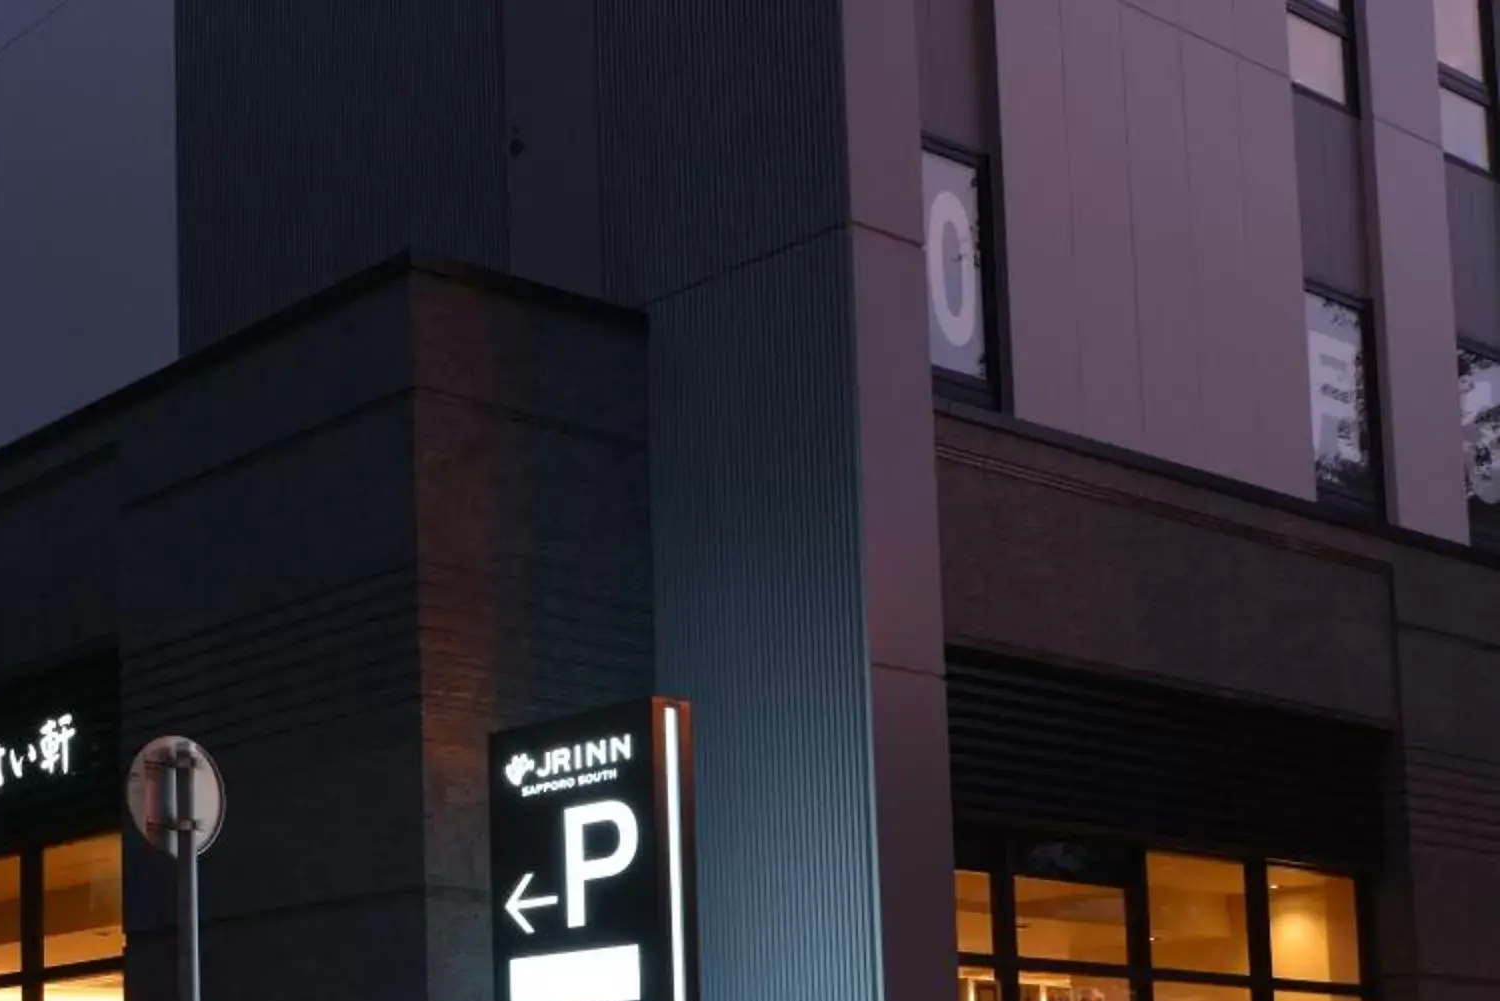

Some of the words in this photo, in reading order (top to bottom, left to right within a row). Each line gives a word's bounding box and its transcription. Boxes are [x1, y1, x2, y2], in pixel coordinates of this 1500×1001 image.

[520, 777, 576, 798] SAPPORO
[577, 768, 618, 787] SOUTH
[563, 800, 639, 929] P
